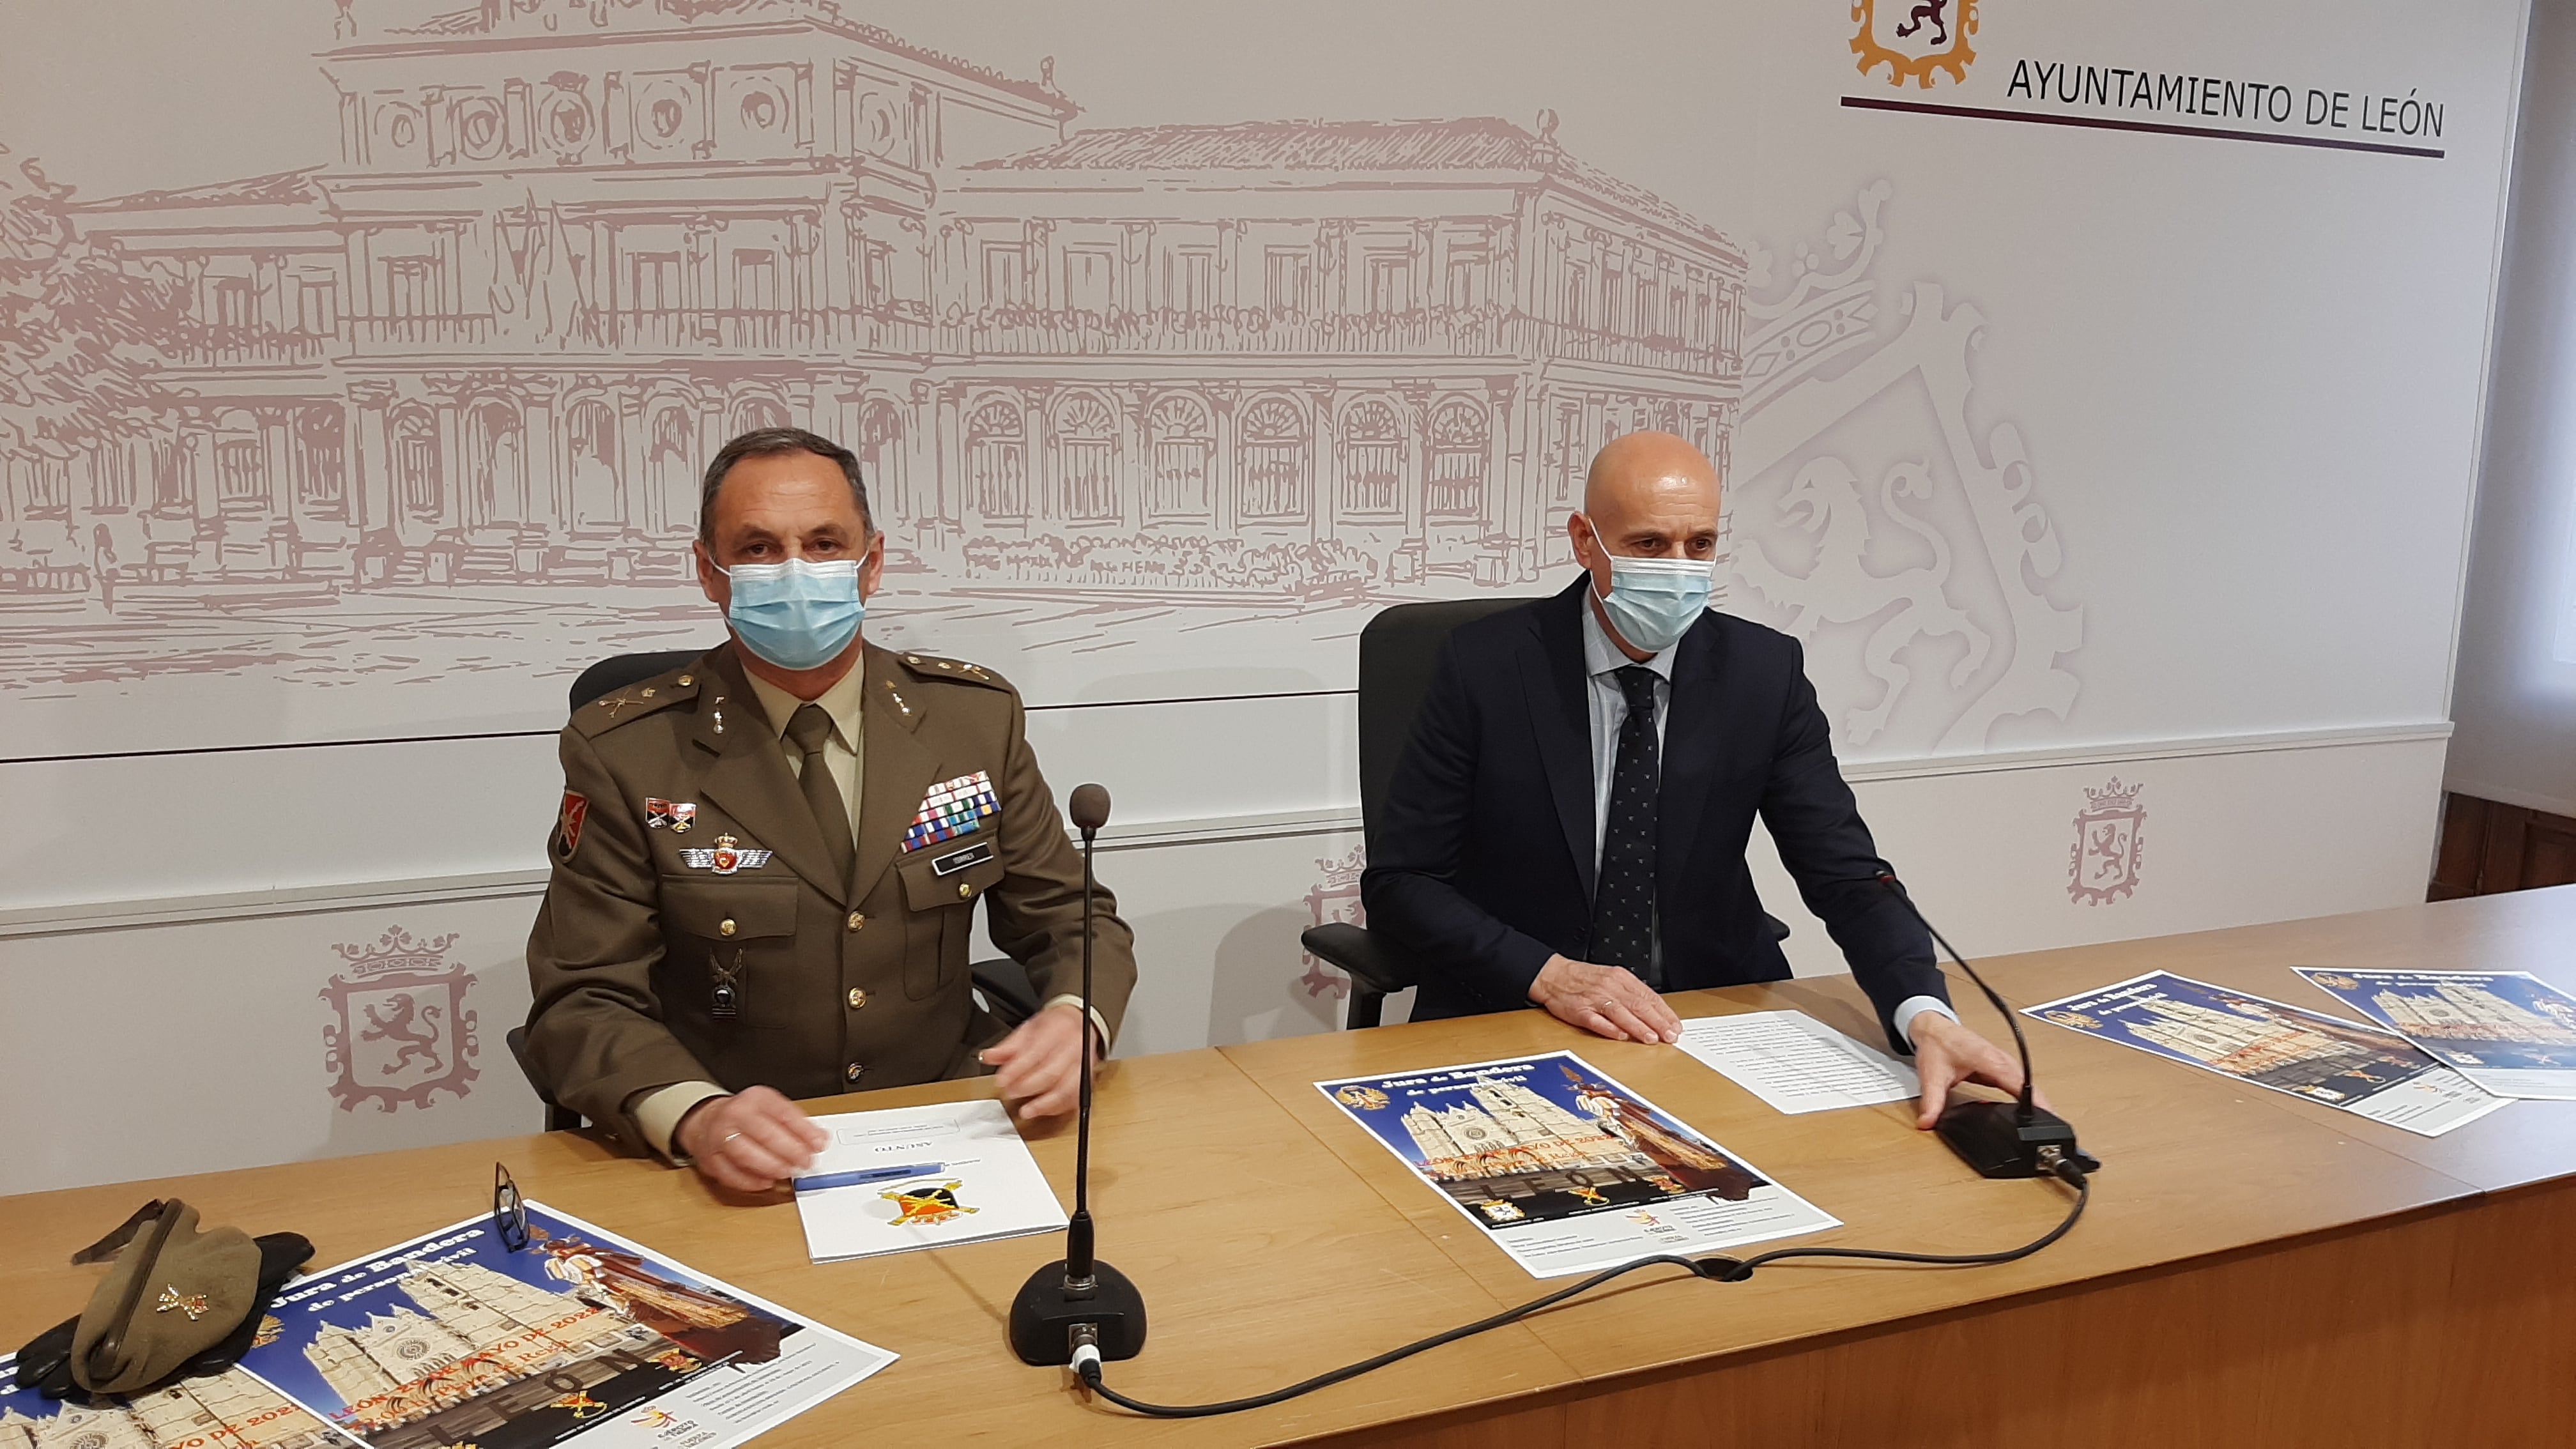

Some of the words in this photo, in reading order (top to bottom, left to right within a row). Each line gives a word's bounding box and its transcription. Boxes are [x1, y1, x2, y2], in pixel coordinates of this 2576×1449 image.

[2007, 59, 2292, 123] AYUNTAMIENTO
[2305, 88, 2350, 128] DE
[2361, 88, 2444, 137] LEÓN
[270, 1282, 338, 1308] Jura
[341, 1271, 367, 1284] de
[365, 1229, 485, 1273] Bandera
[307, 1300, 335, 1312] de
[519, 1328, 551, 1342] DE
[550, 1307, 599, 1330] 2022
